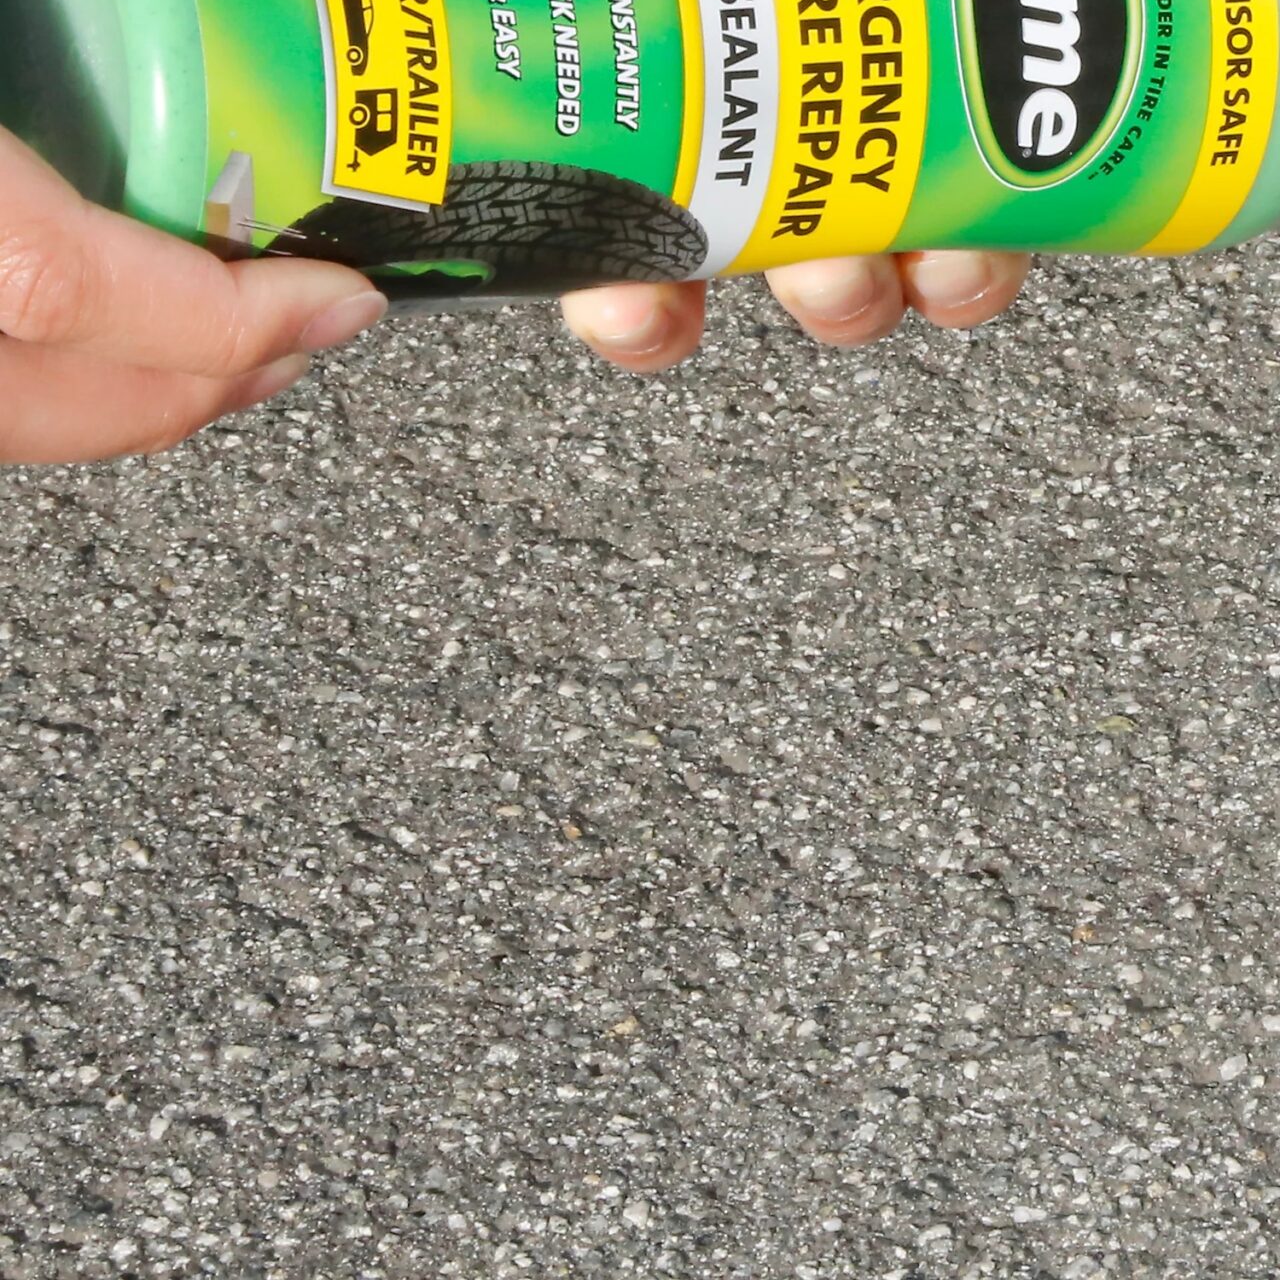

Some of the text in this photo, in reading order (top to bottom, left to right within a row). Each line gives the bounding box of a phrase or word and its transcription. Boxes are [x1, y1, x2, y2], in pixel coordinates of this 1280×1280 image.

[490, 7, 522, 81] EASY
[553, 23, 581, 136] NEEDED
[1153, 44, 1172, 71] IN
[1136, 75, 1166, 122] TIRE
[1209, 86, 1251, 168] SAFE
[770, 60, 844, 240] REPAIR
